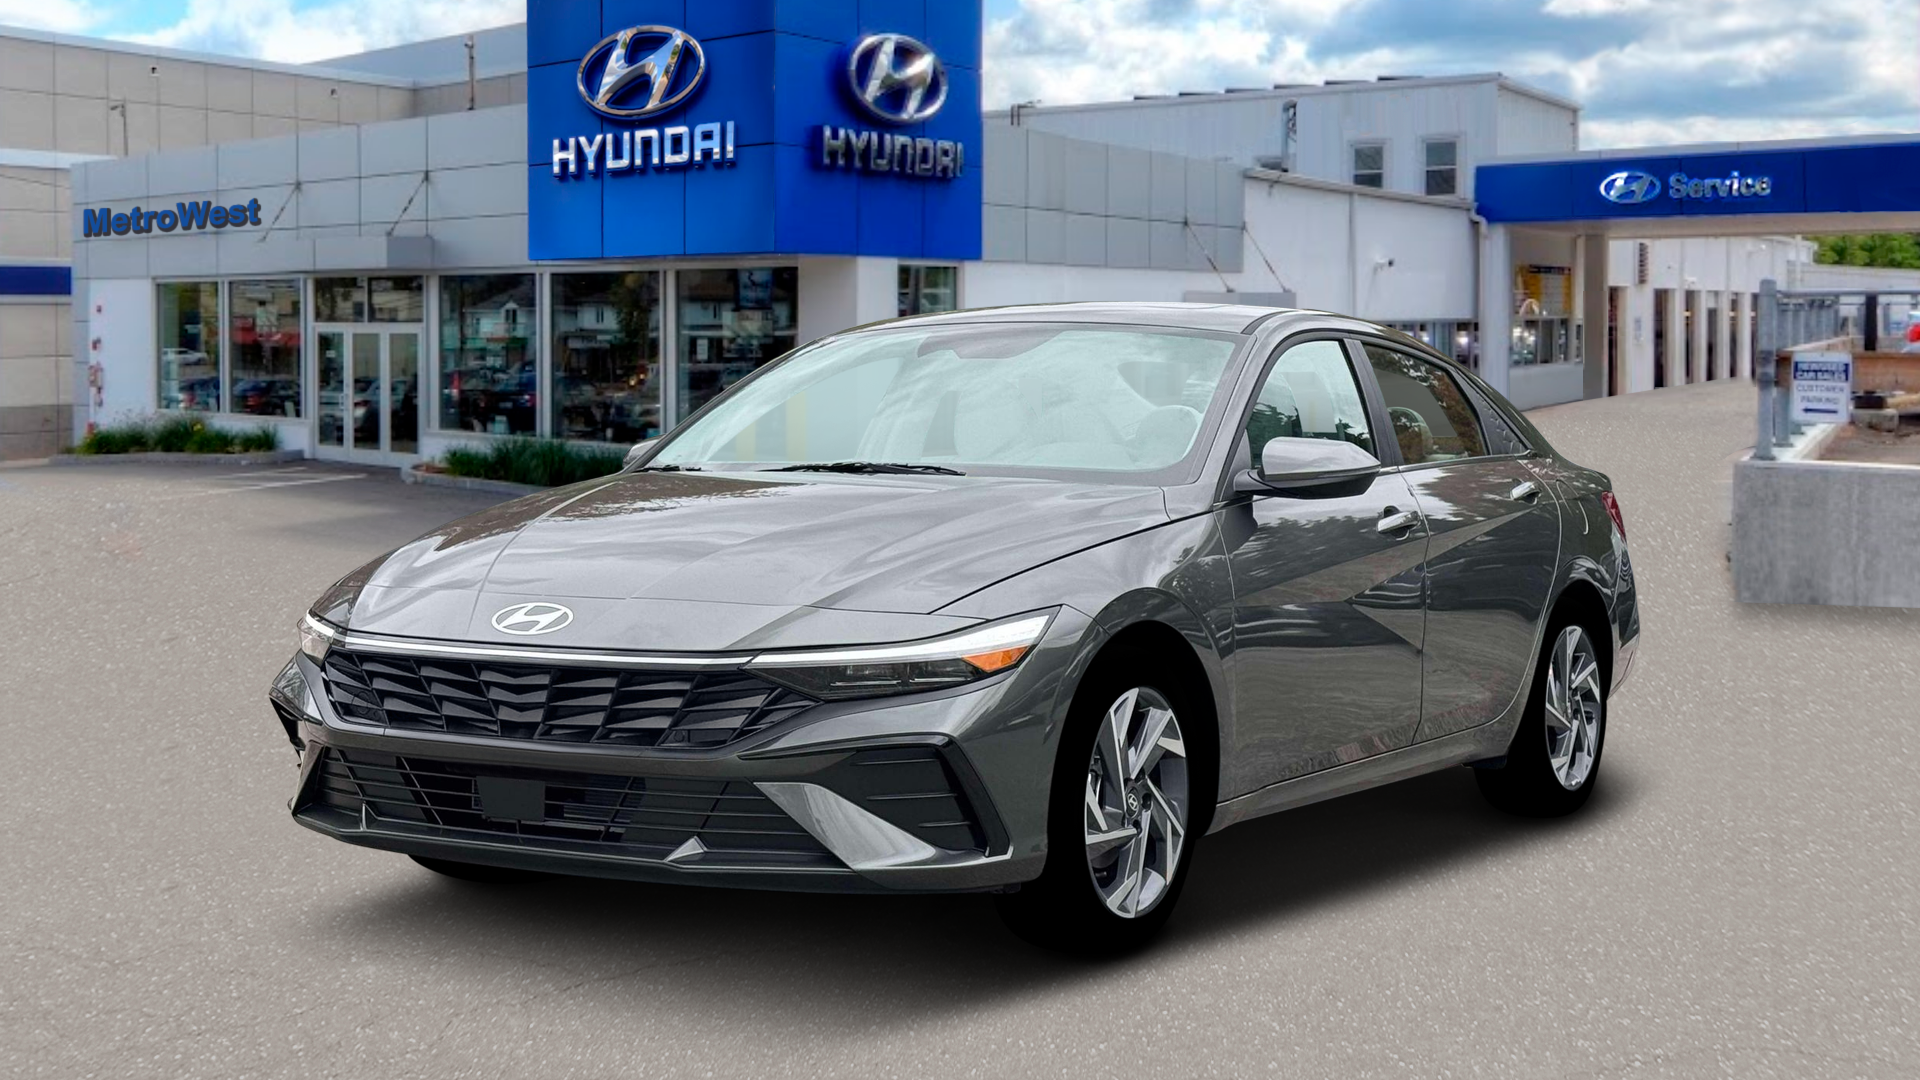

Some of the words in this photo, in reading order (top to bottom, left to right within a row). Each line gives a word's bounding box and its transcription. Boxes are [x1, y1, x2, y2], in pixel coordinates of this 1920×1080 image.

[553, 121, 735, 178] HYUNDAI
[822, 125, 964, 179] HYUNDAI
[1668, 170, 1772, 199] Service
[83, 198, 262, 237] MetroWest
